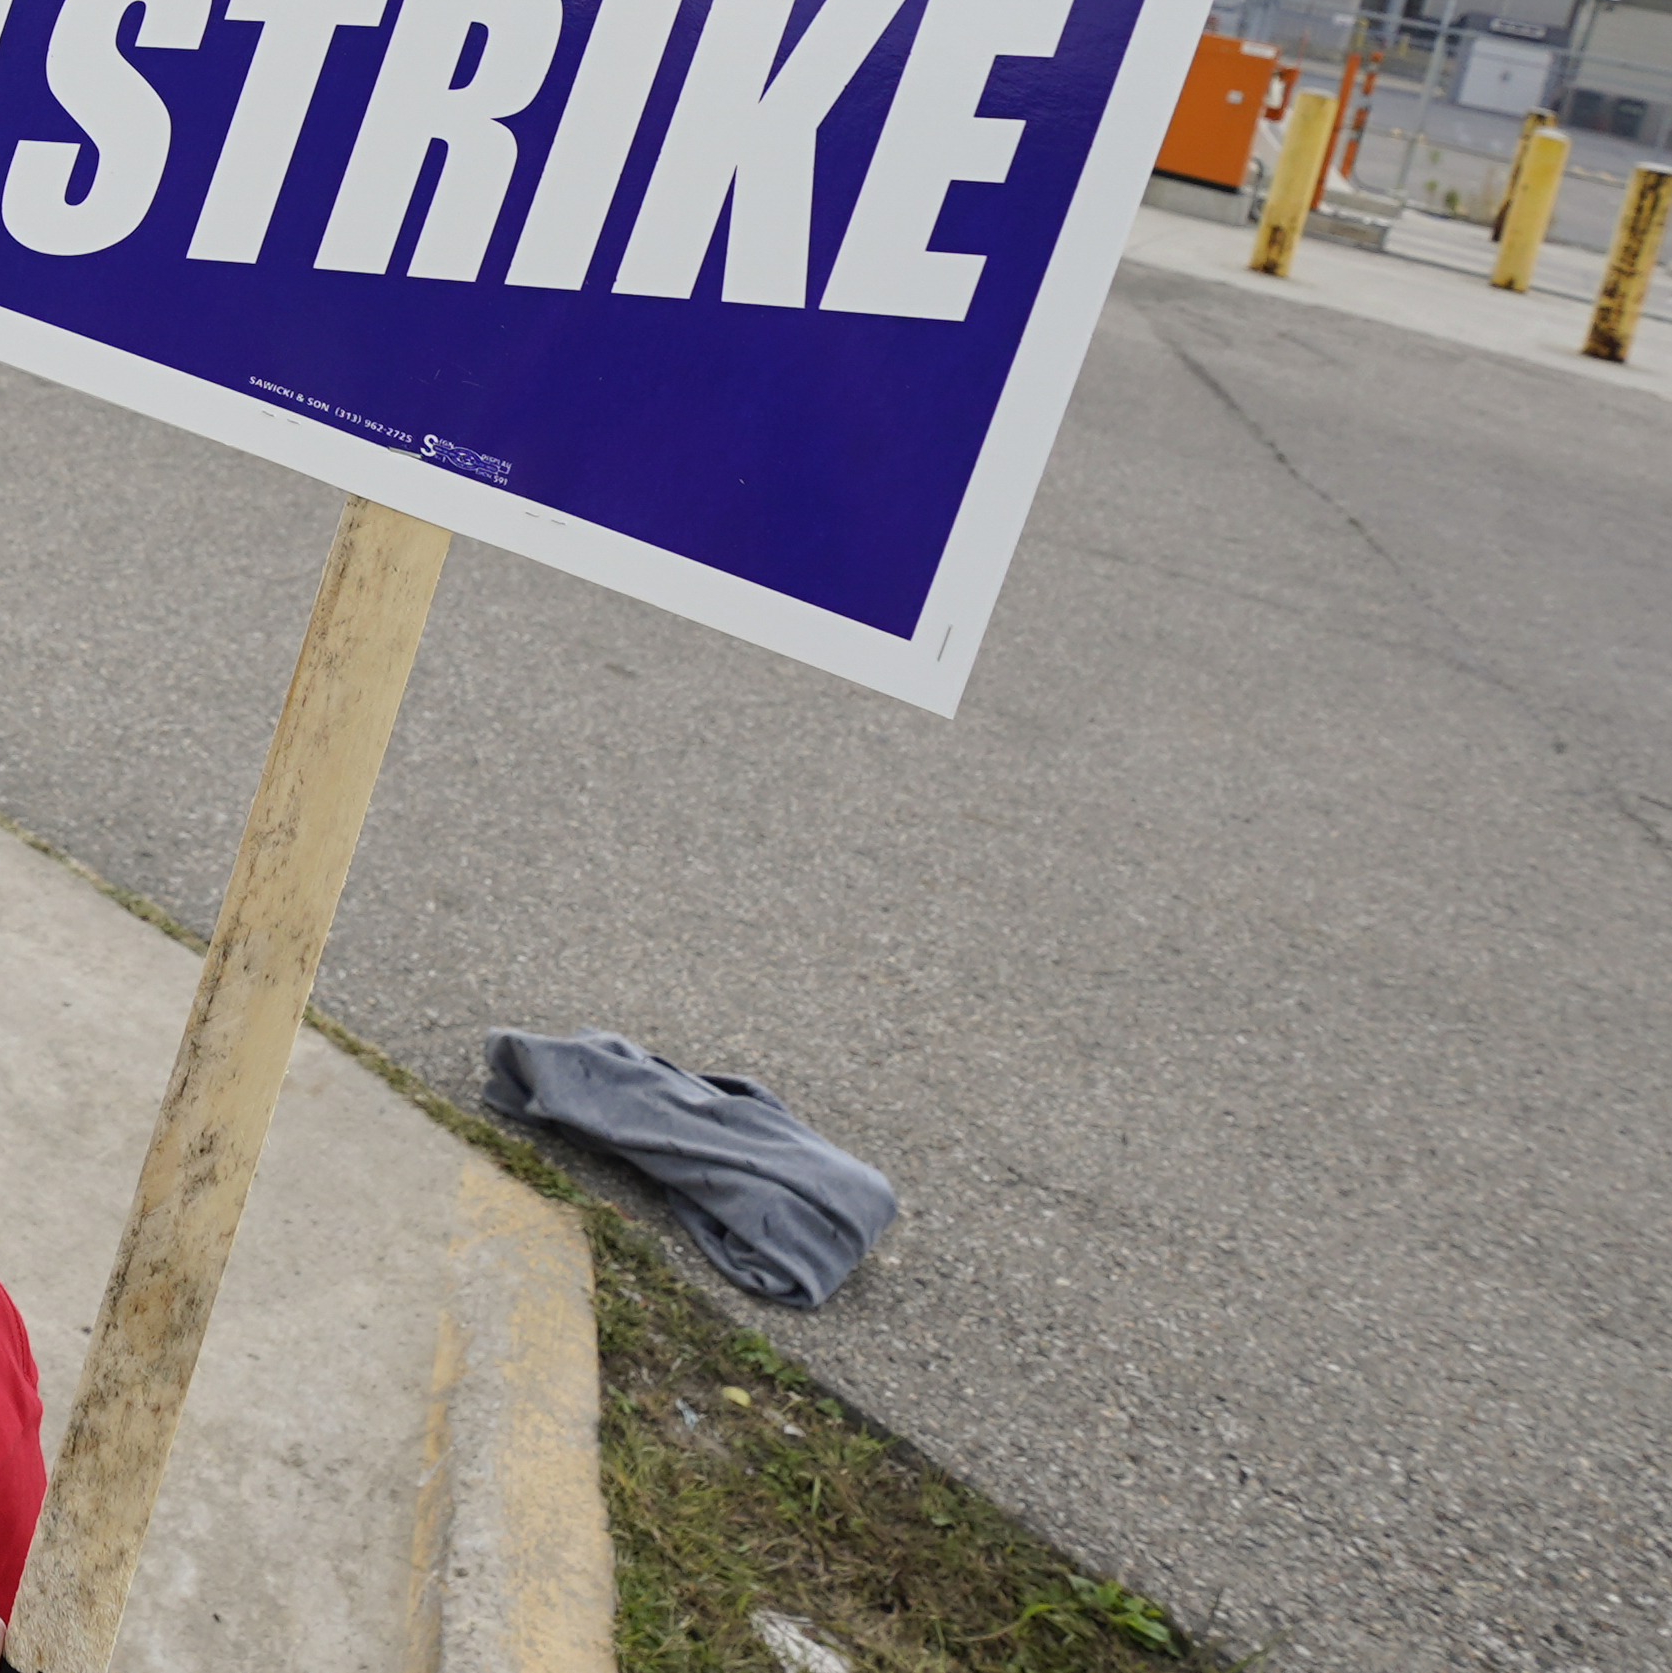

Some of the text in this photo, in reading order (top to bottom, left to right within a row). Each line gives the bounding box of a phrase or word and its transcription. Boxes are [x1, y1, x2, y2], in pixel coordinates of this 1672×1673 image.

[248, 375, 414, 445] SAWICKI & SON (313) 962-2725
